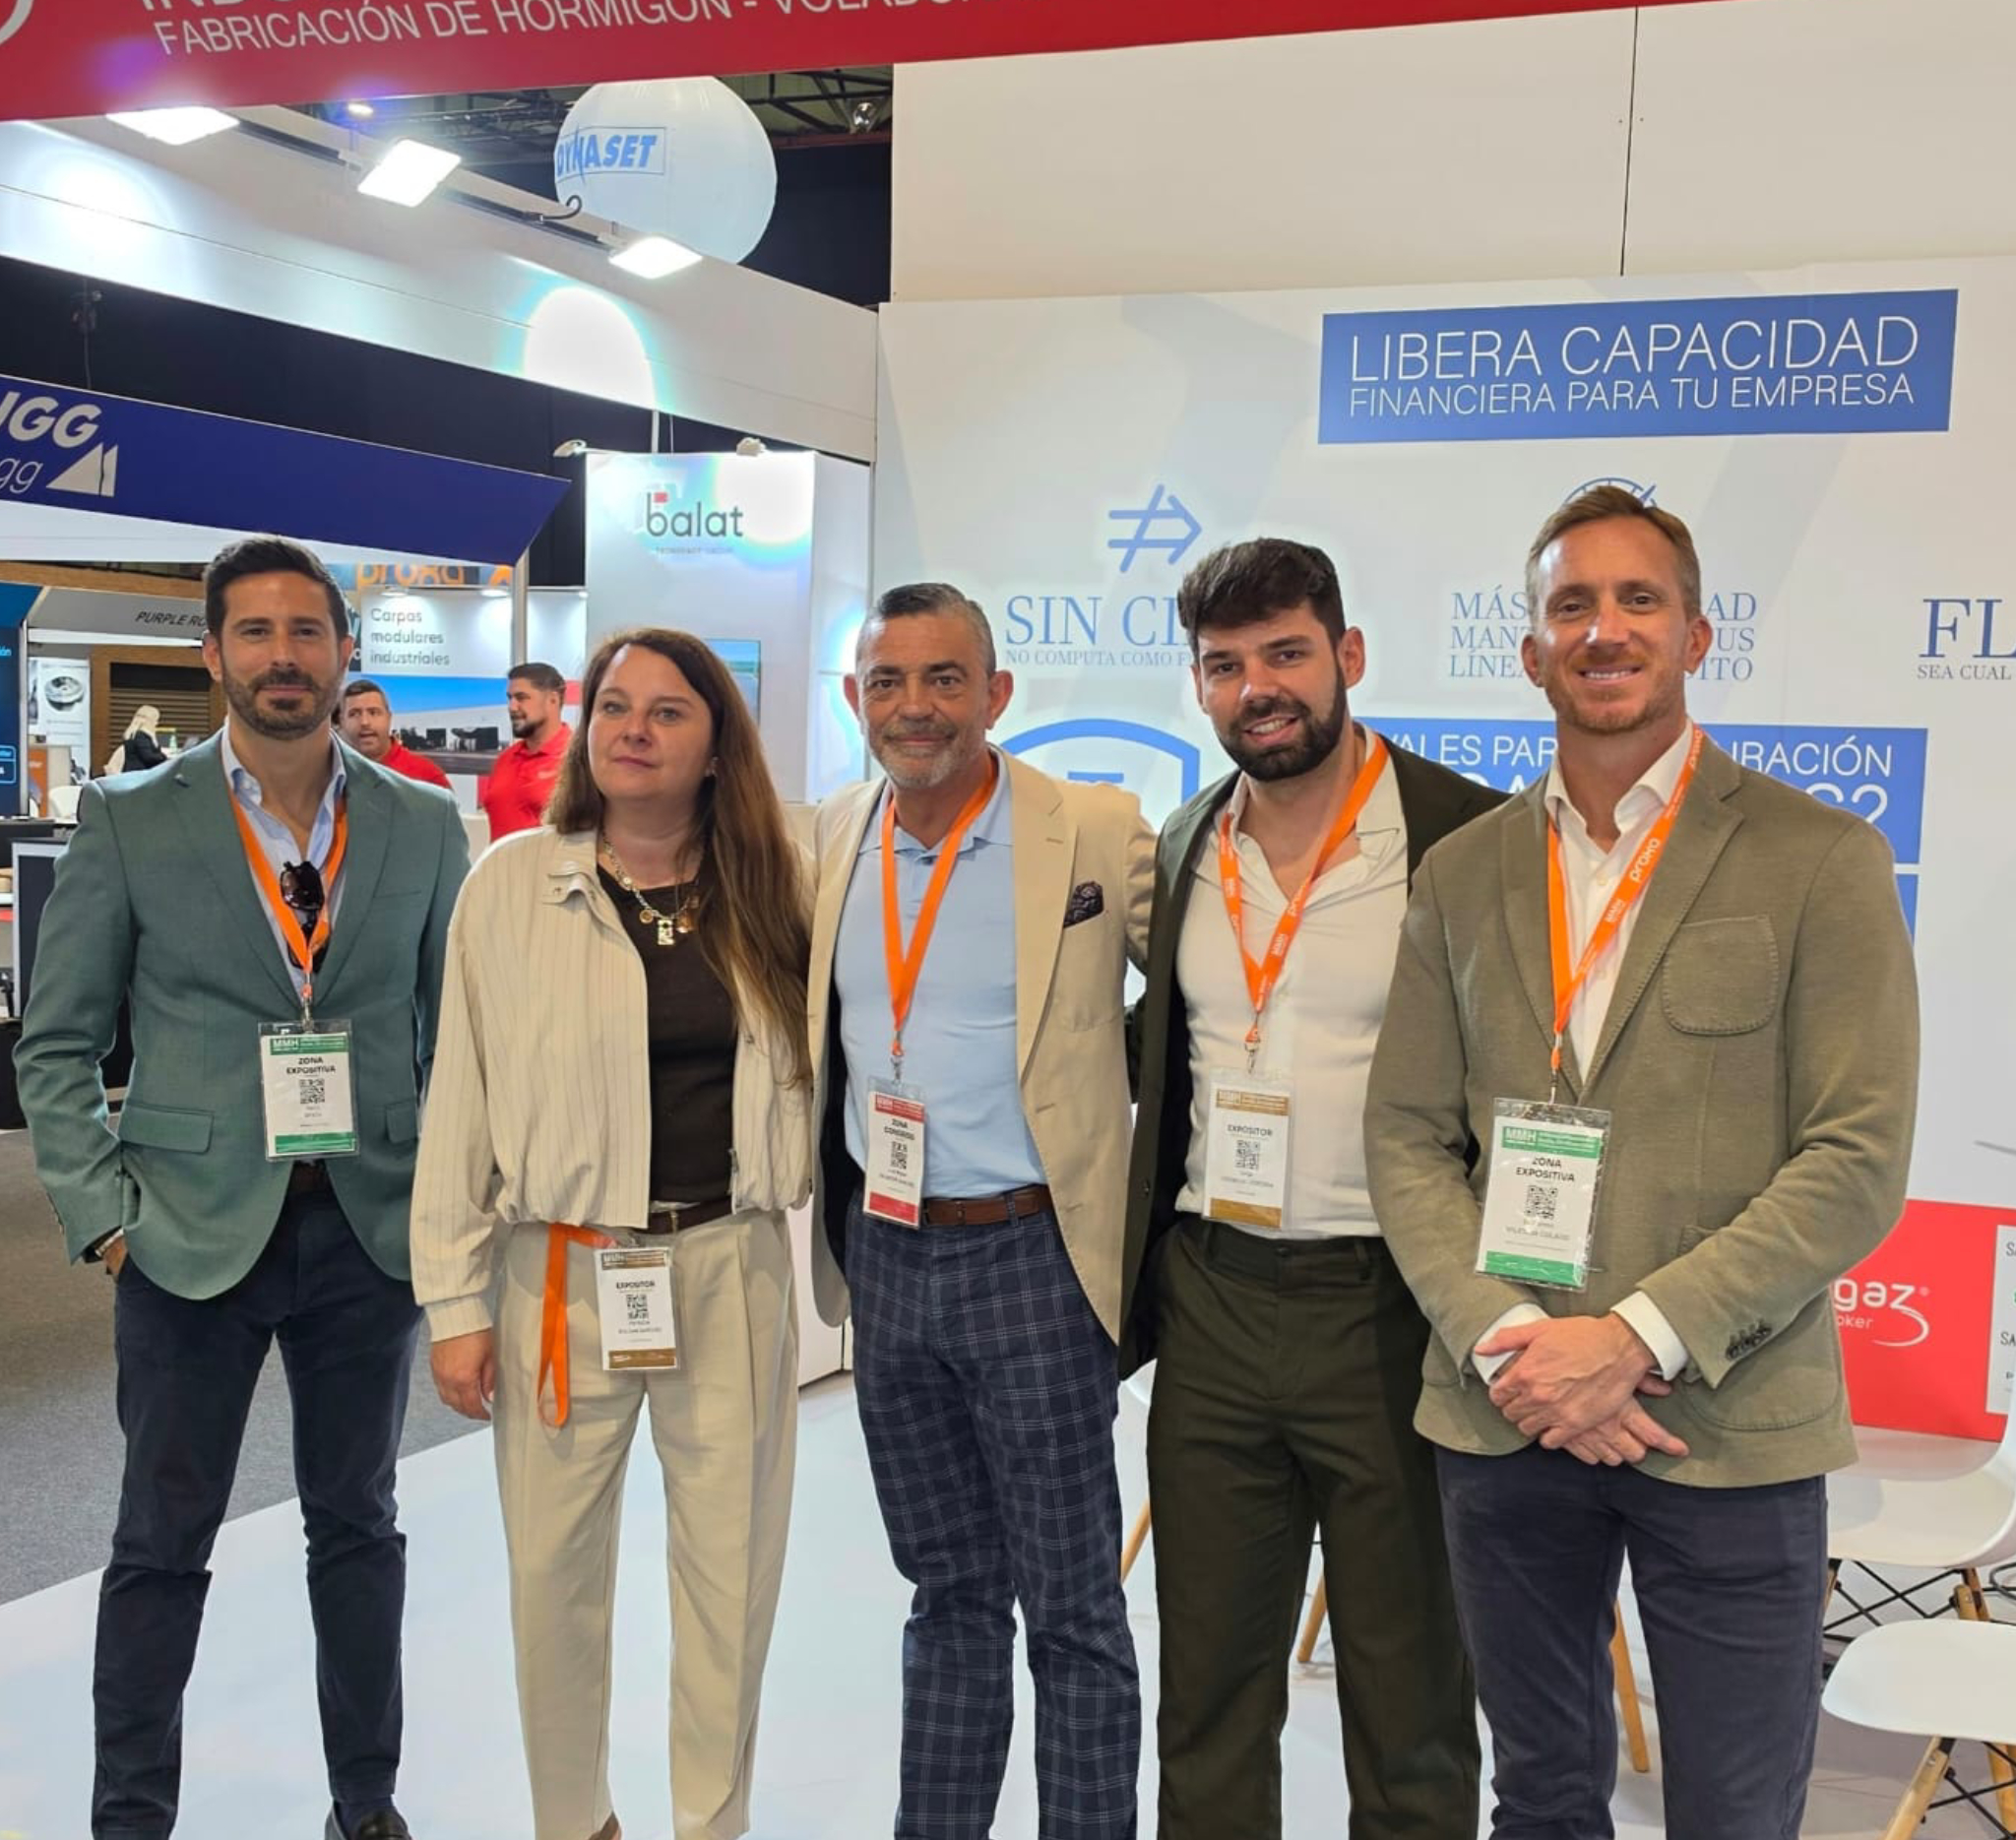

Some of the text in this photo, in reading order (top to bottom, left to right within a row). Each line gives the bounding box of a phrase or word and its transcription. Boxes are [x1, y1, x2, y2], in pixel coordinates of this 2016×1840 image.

[424, 0, 488, 37] DE
[556, 124, 658, 183] DYNASET
[1352, 316, 1919, 382] LIBERA CAPACIDAD
[1351, 371, 1915, 417] FINANCIERA PARA TU EMPRESA
[647, 491, 744, 538] balat
[1451, 584, 1527, 620] MÁS
[135, 610, 188, 626] PURPLE
[370, 607, 422, 625] Carpas
[1005, 595, 1190, 648] SIN CI
[370, 629, 444, 644] modulares
[370, 650, 450, 666] industriales
[1006, 650, 1031, 666] NO
[1034, 650, 1116, 666] COMPUTA
[1120, 651, 1173, 667] COMO
[1450, 649, 1524, 677] LÍNE
[1917, 664, 2012, 680] SEA CUAL
[1228, 1124, 1273, 1136] EXPOSITOR
[1533, 1158, 1562, 1168] ZONA
[1516, 1168, 1575, 1181] EXPOSITIVA
